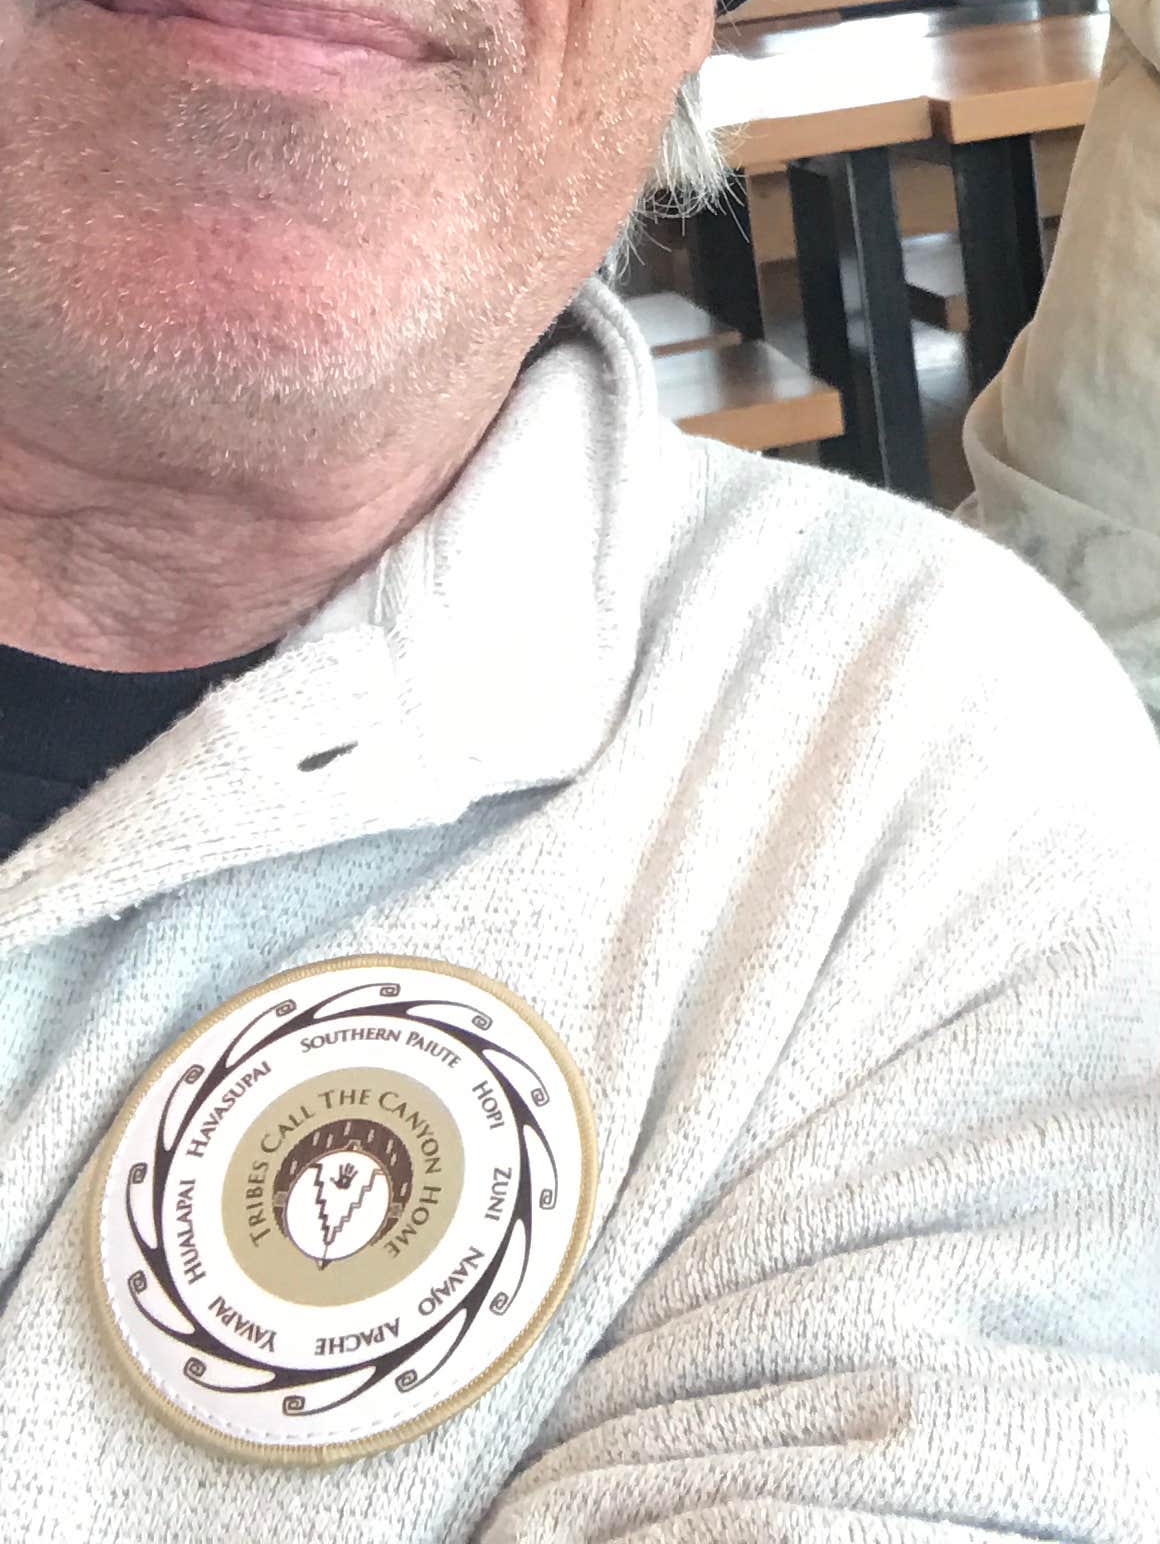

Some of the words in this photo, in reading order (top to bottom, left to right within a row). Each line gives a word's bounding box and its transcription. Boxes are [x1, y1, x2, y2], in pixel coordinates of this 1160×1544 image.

[300, 1027, 402, 1053] SOUTHERN
[405, 1030, 462, 1069] PAIUTE
[186, 1060, 272, 1158] HAVASUPAI
[318, 1088, 371, 1109] THE
[472, 1080, 505, 1130] HOPI
[260, 1105, 316, 1153] CALL
[378, 1091, 441, 1175] CANYON
[246, 1159, 272, 1247] TRIBES
[384, 1185, 442, 1258] HOME
[484, 1167, 512, 1221] ZUNI
[176, 1178, 207, 1285] HUALAPAI
[417, 1246, 485, 1316] NAVAJO
[207, 1295, 278, 1353] YAVAPAI
[314, 1317, 401, 1356] APACHE
